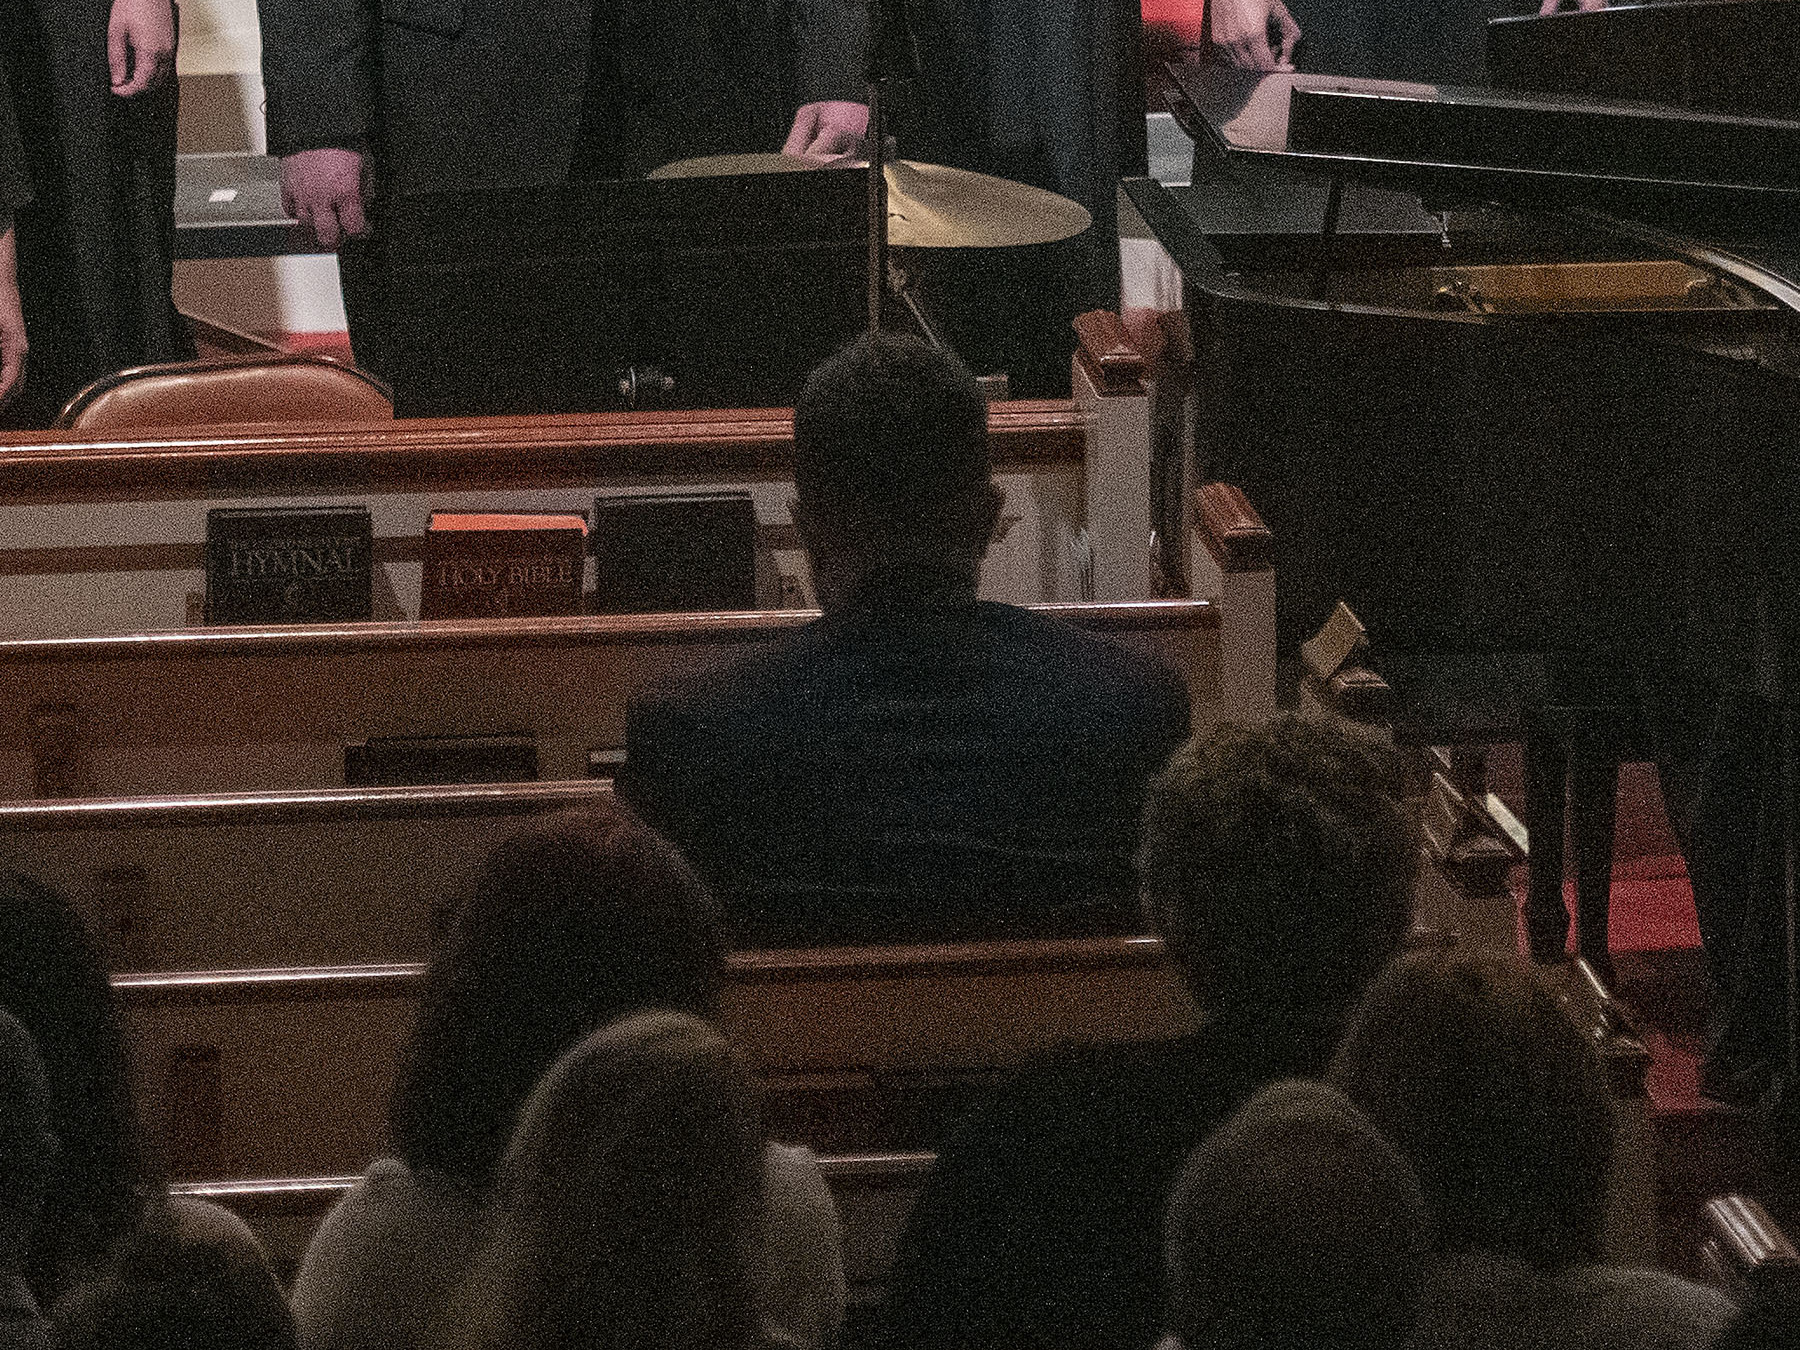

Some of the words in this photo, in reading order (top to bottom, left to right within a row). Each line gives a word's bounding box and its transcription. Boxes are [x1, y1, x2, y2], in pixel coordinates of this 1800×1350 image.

[229, 546, 365, 577] HYMNAL
[437, 561, 502, 587] HOLY
[508, 561, 573, 585] BIBLE
